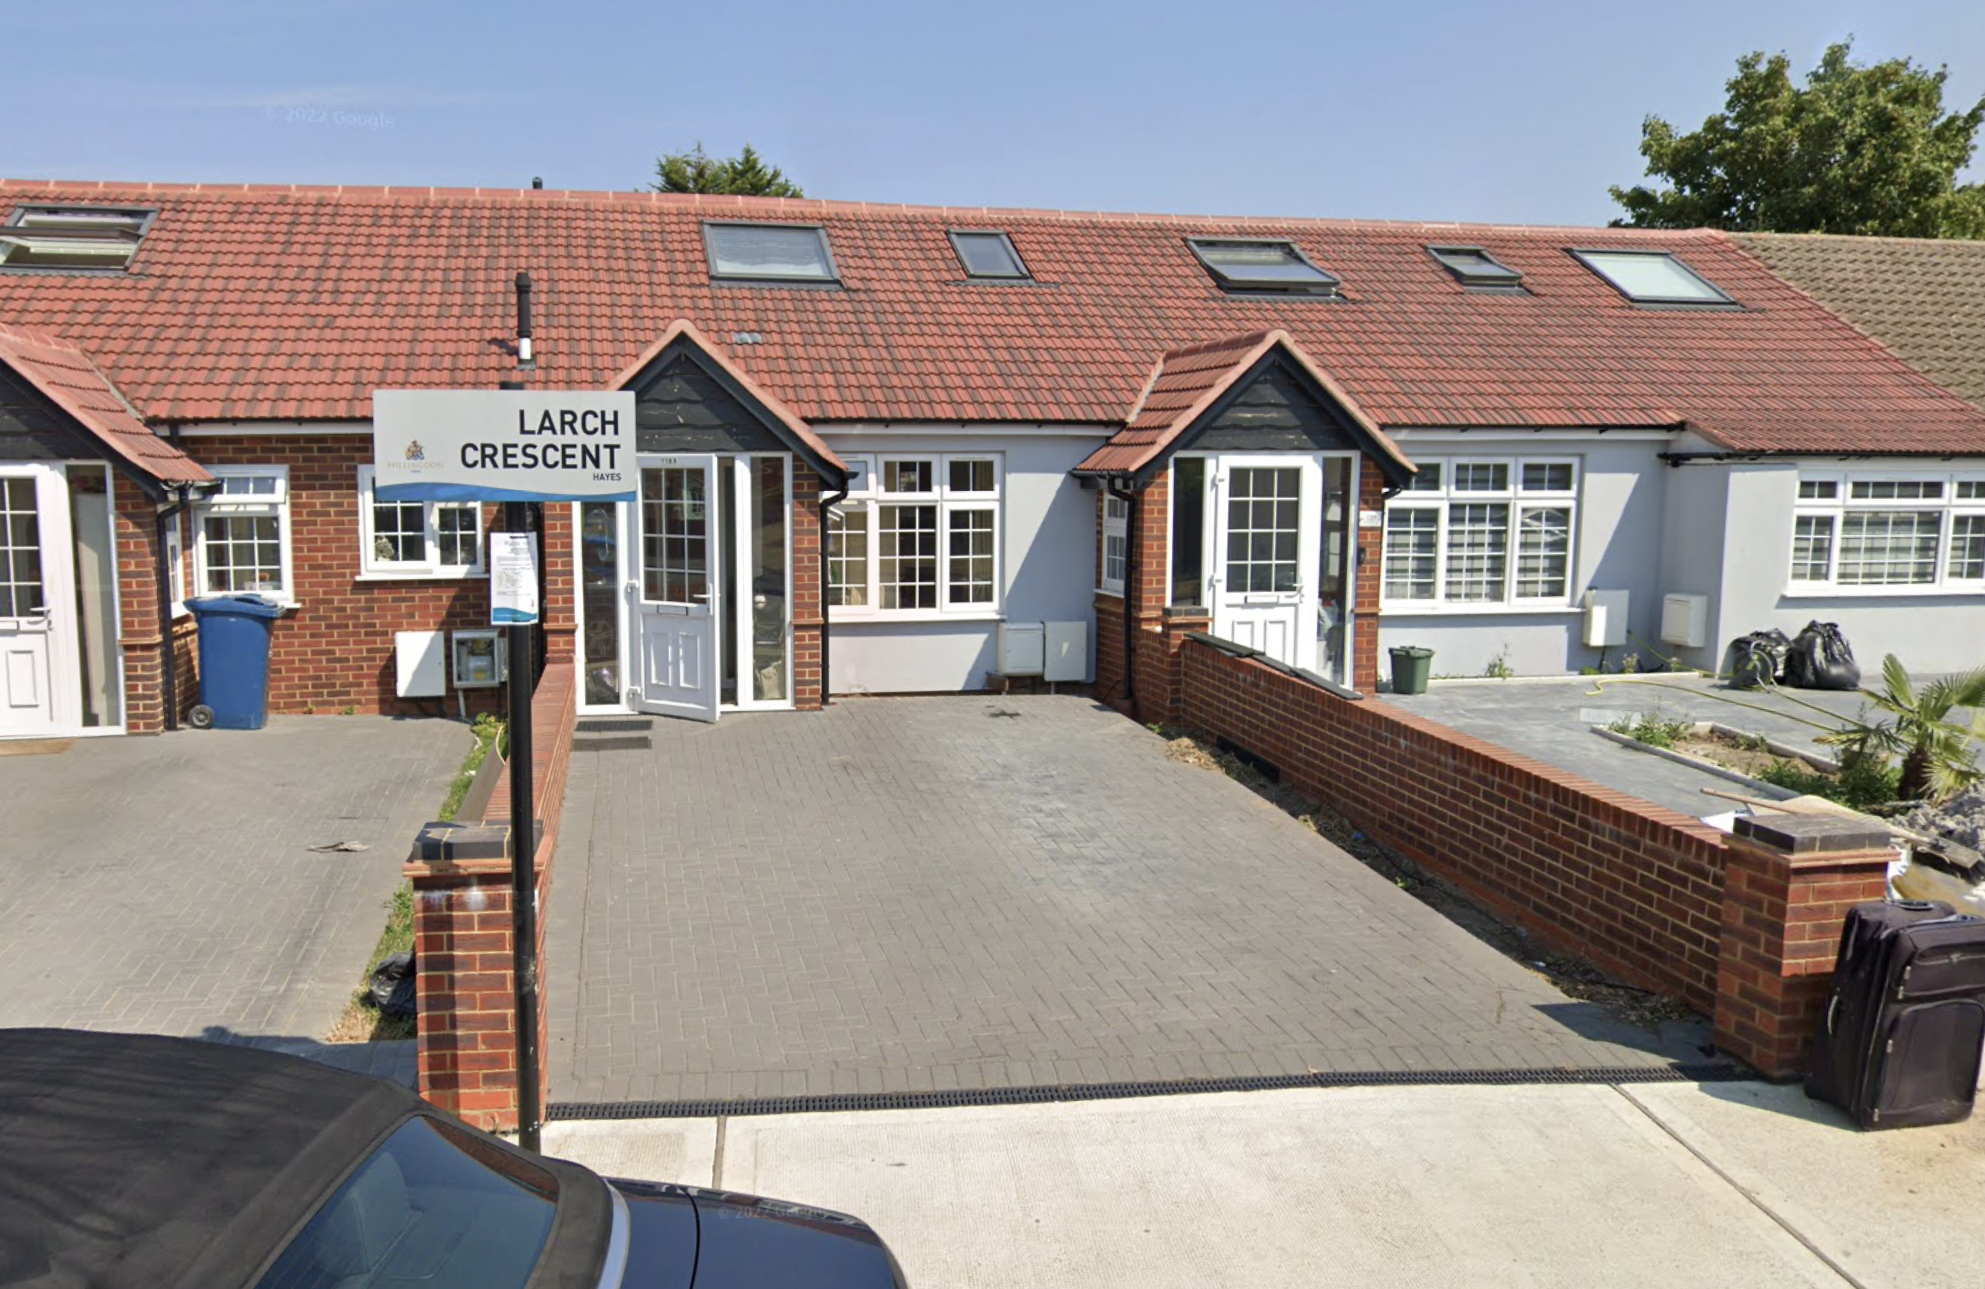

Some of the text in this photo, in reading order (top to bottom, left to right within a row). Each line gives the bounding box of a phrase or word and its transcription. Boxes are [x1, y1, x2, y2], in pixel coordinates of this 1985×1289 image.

[519, 409, 619, 436] LARCH
[460, 442, 621, 470] CRESCENT
[387, 461, 444, 470] HILLINGDON
[593, 472, 622, 481] HAYES
